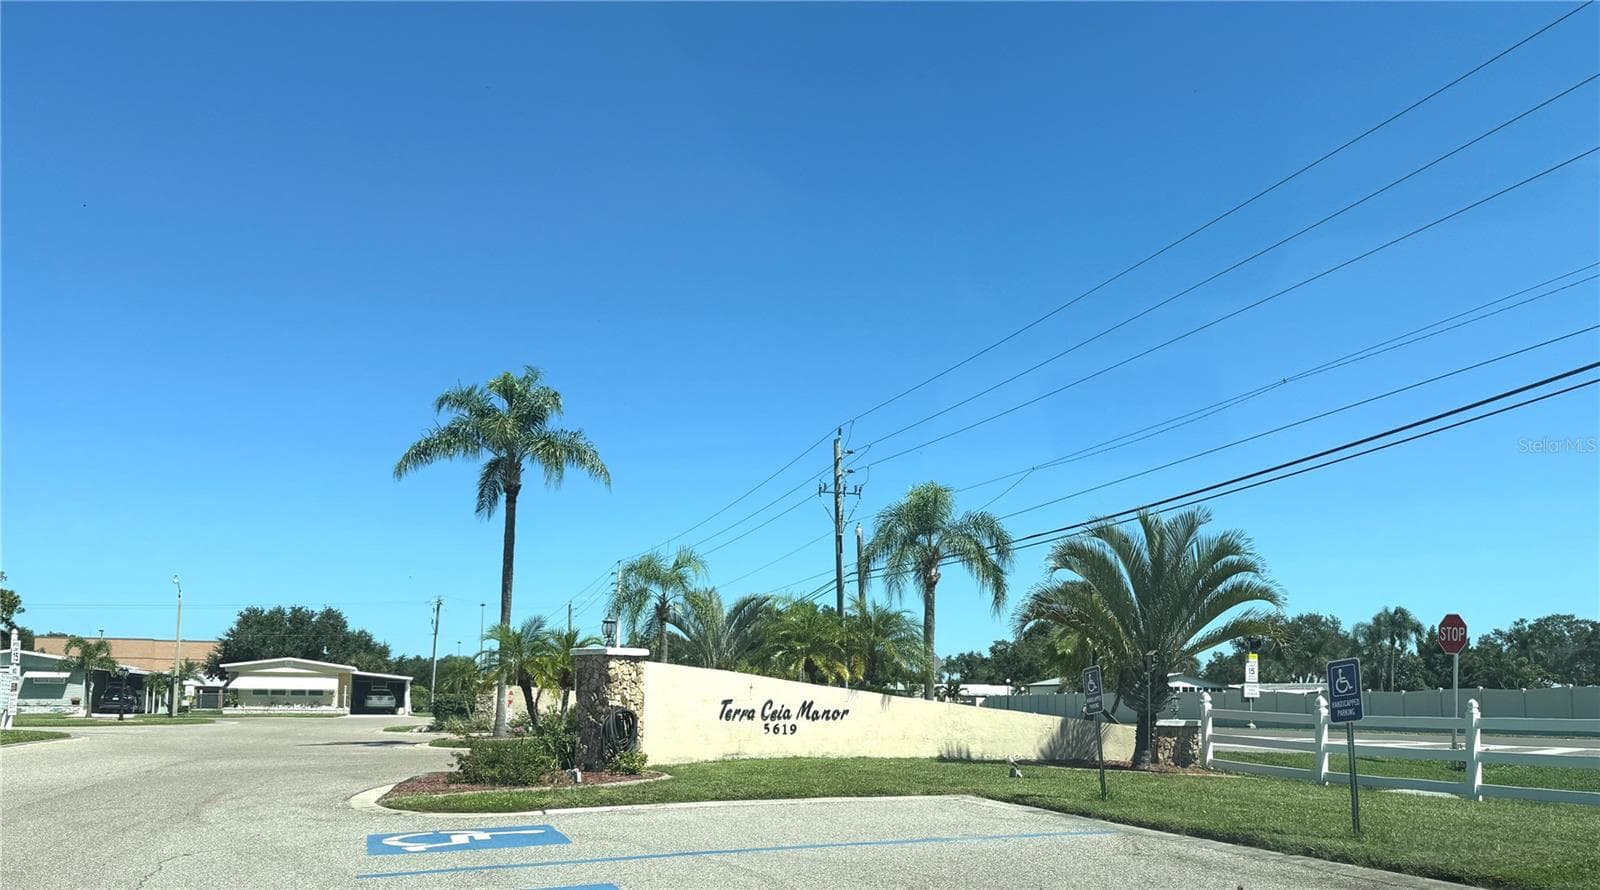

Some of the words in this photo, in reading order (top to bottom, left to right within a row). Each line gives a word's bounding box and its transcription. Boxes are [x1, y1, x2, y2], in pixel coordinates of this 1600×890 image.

[1440, 626, 1465, 642] STOP
[1248, 667, 1256, 675] 15
[1332, 698, 1361, 708] HANDICAPPED
[719, 699, 756, 722] Terra
[760, 699, 793, 721] Ceia
[796, 700, 850, 722] Manor
[1337, 708, 1356, 717] PARKING
[763, 723, 798, 735] 5619
